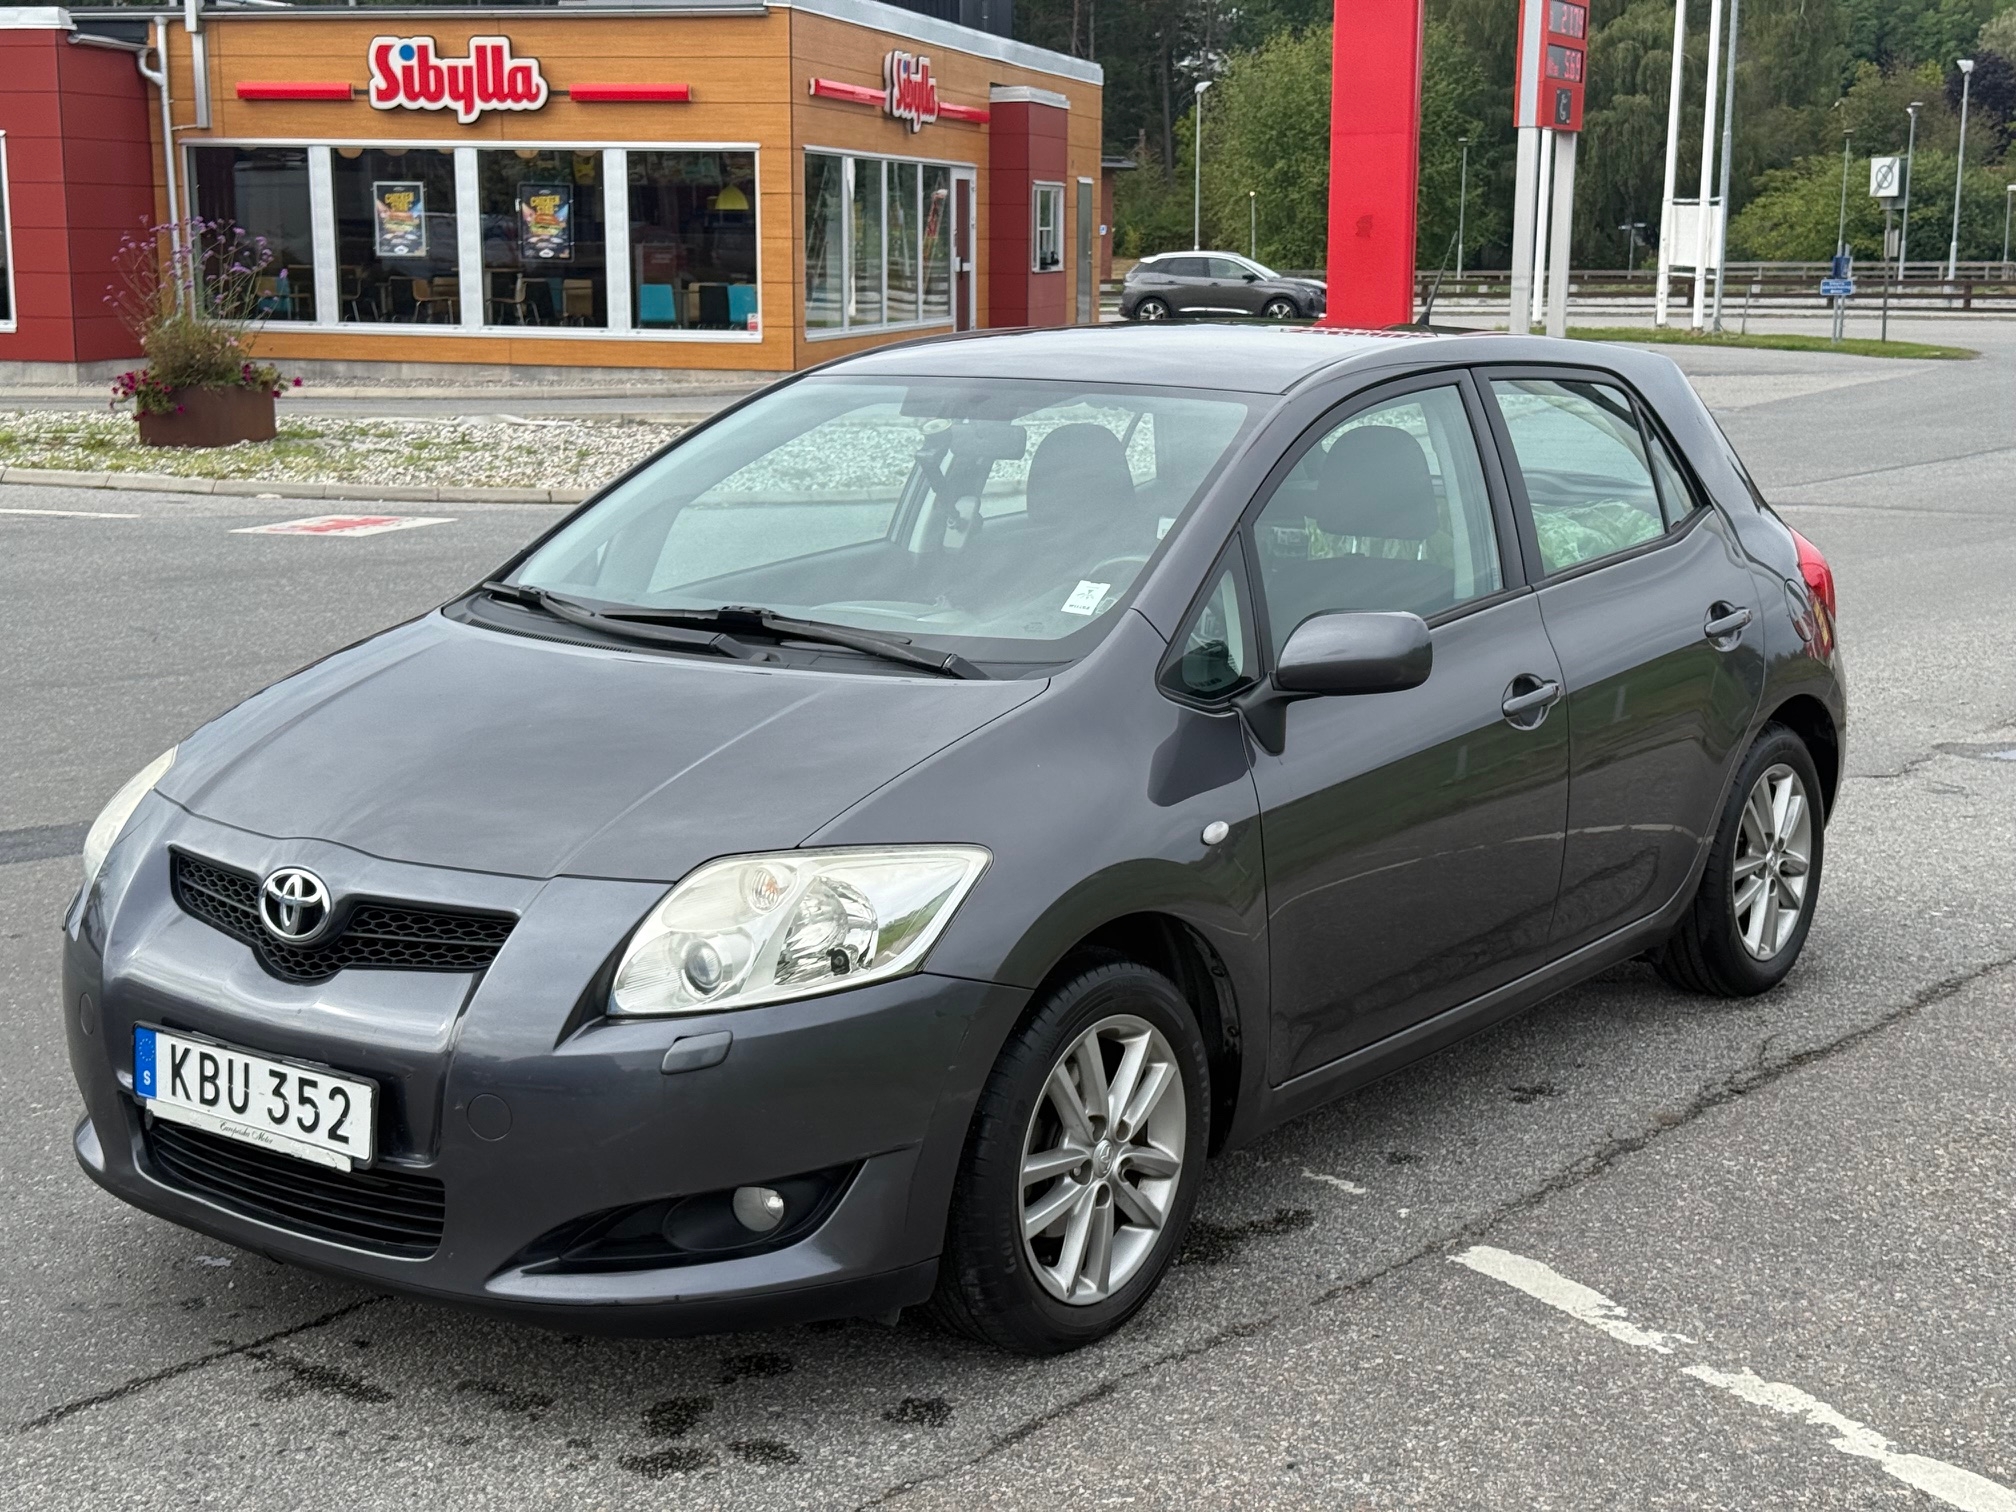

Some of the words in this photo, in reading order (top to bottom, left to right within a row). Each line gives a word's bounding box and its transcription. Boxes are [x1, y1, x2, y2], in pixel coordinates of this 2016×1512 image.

[374, 44, 541, 116] Sibylla
[895, 58, 936, 126] Sibylla
[143, 1070, 151, 1086] S
[170, 1043, 250, 1115] KBU
[267, 1068, 351, 1145] 352
